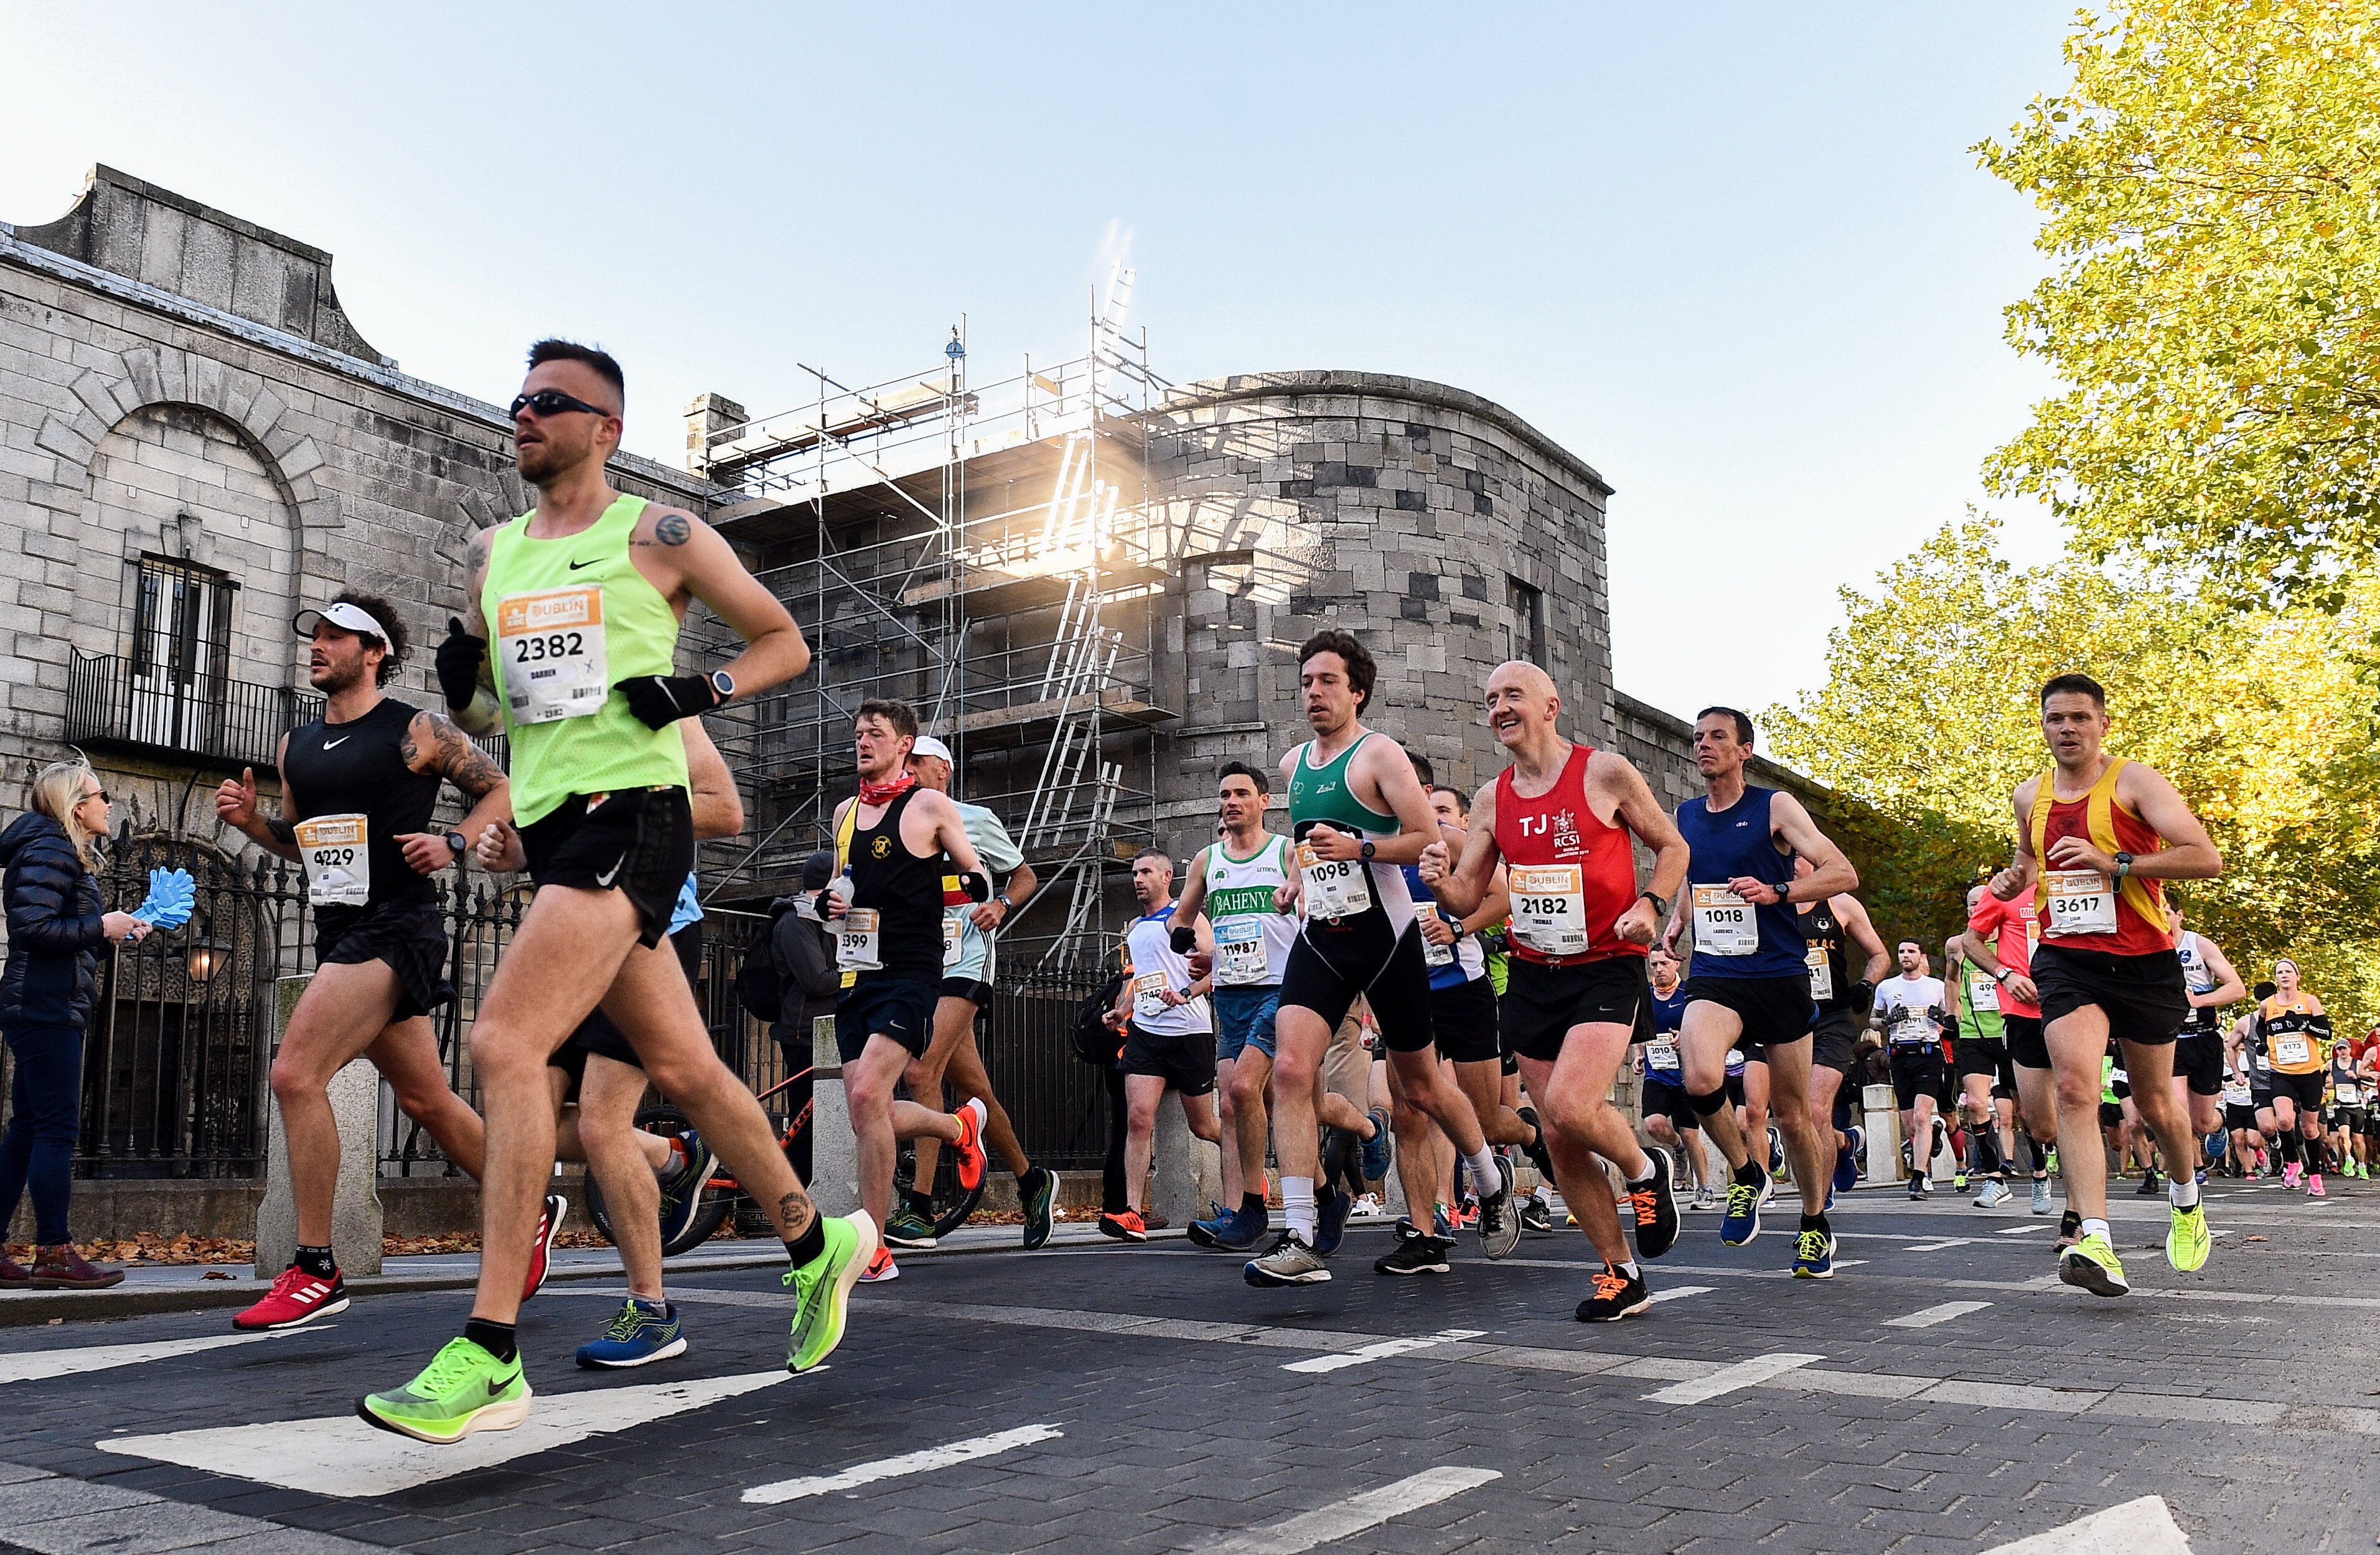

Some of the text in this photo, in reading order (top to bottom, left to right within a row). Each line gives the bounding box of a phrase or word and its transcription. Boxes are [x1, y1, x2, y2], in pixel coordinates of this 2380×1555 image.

[533, 601, 583, 616] DUBLIN
[515, 632, 583, 663] 2382
[530, 668, 556, 679] DARREN
[319, 825, 355, 835] DUBLIN
[1519, 813, 1547, 837] TJ
[1553, 834, 1580, 848] RCSI
[314, 848, 355, 866] 4229
[1310, 862, 1350, 883] 1098
[1529, 876, 1568, 884] DUBLIN
[2066, 878, 2100, 887] DUBLIN
[1216, 891, 1268, 911] RAHENY
[1520, 897, 1568, 914] 2182
[2056, 897, 2099, 913] 3617
[1705, 910, 1743, 923] 1018
[1223, 941, 1258, 956] 11987
